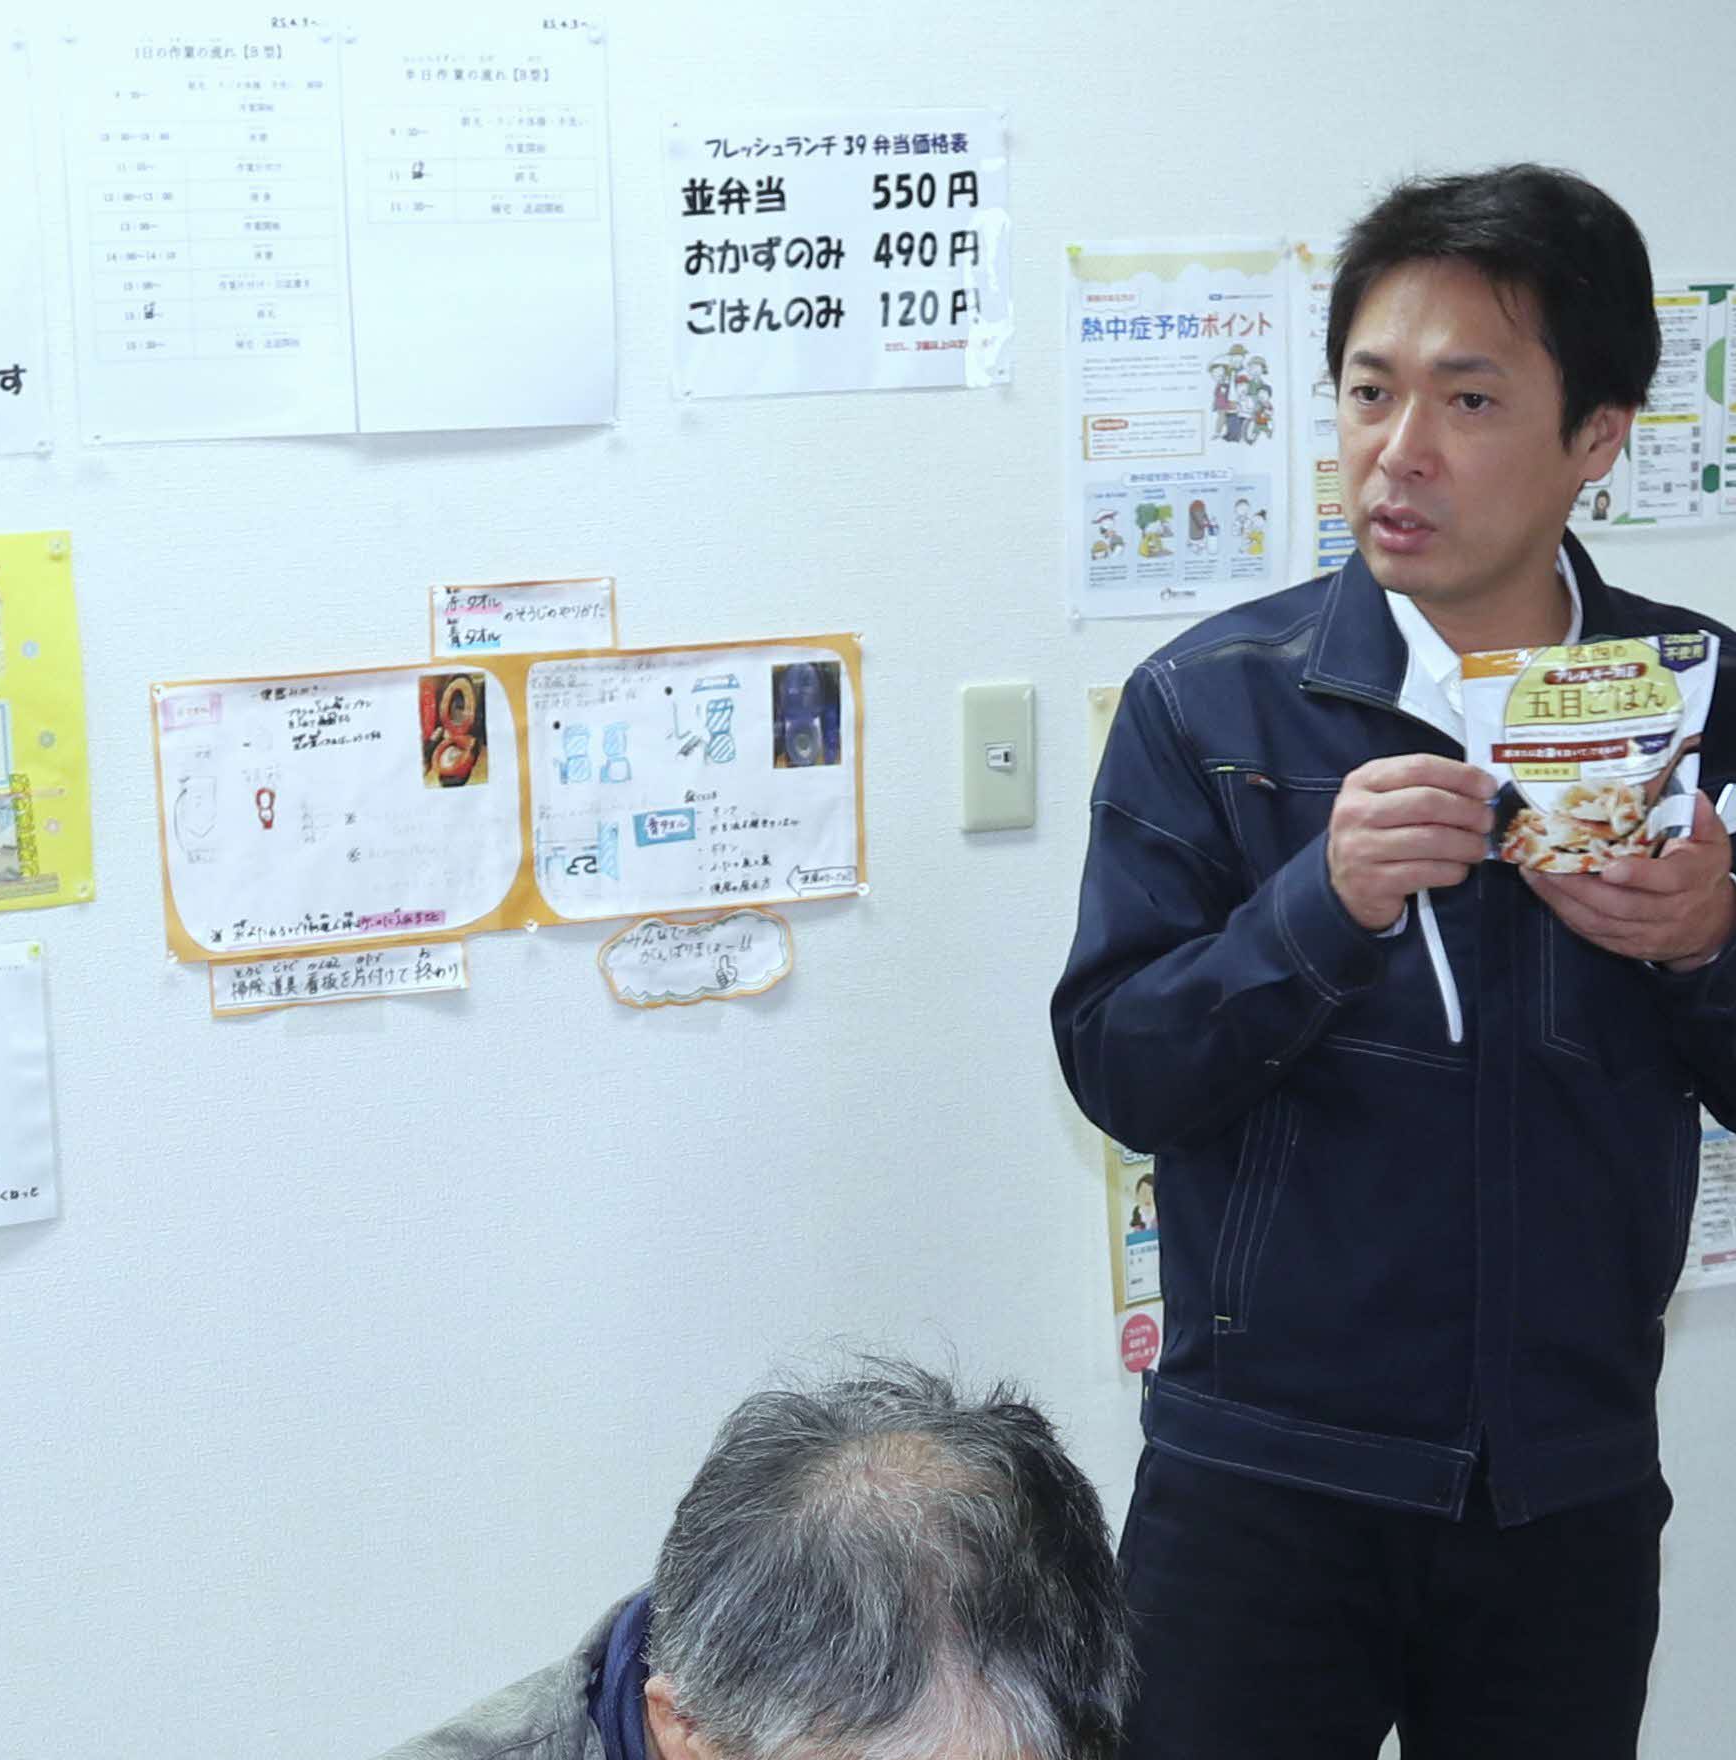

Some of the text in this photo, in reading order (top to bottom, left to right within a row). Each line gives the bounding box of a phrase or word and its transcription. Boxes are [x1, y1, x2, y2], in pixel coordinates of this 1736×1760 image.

[705, 132, 969, 159] フレッシュランチ 39 弁当価格表
[681, 170, 979, 217] 並弁当 550 円
[684, 230, 980, 276] おかずのみ 490 円
[686, 295, 845, 335] ごはんのみ
[879, 291, 939, 328] 120
[1080, 312, 1273, 342] 熱中症予防ポイント
[1525, 681, 1667, 718] 五目ごはん
